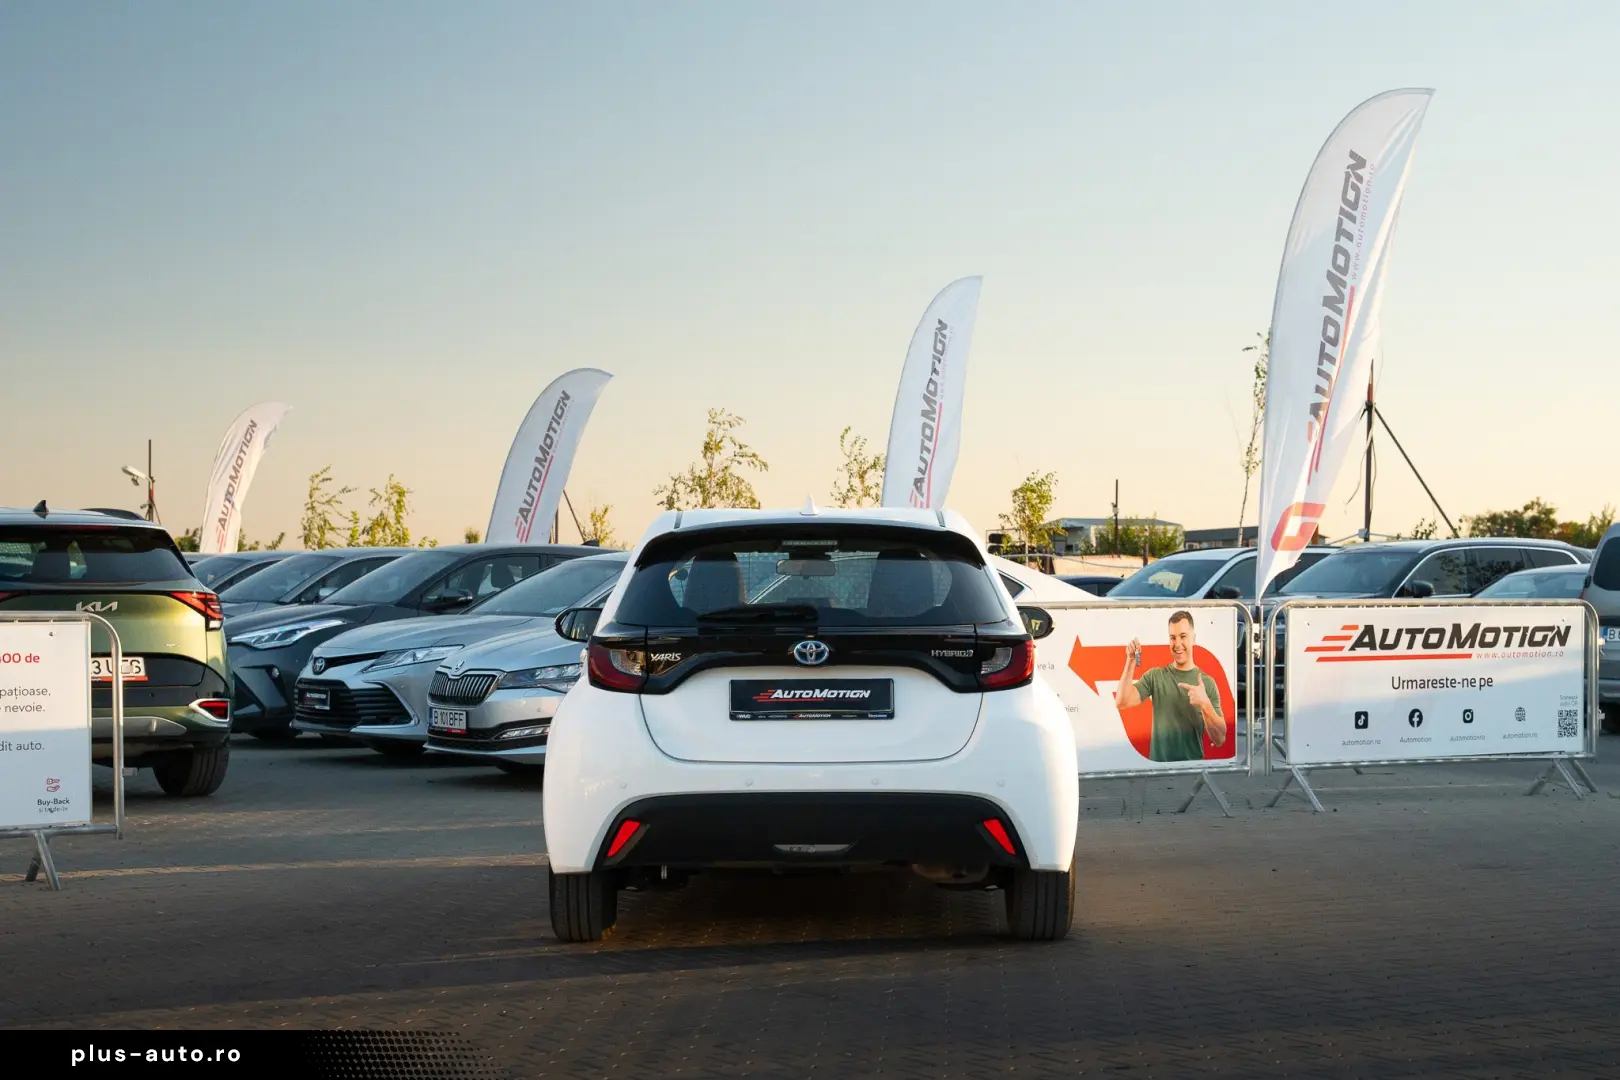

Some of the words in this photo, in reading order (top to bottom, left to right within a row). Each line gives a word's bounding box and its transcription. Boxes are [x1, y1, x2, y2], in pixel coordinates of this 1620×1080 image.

[25, 653, 40, 663] de
[650, 652, 682, 662] YARIS
[1476, 649, 1564, 660] www.automotion.ro
[1391, 676, 1476, 690] Urmareste-ne
[1479, 677, 1494, 692] pe
[4, 702, 46, 712] nevoie.
[16, 741, 45, 751] auto.
[37, 797, 70, 806] Buy-Back
